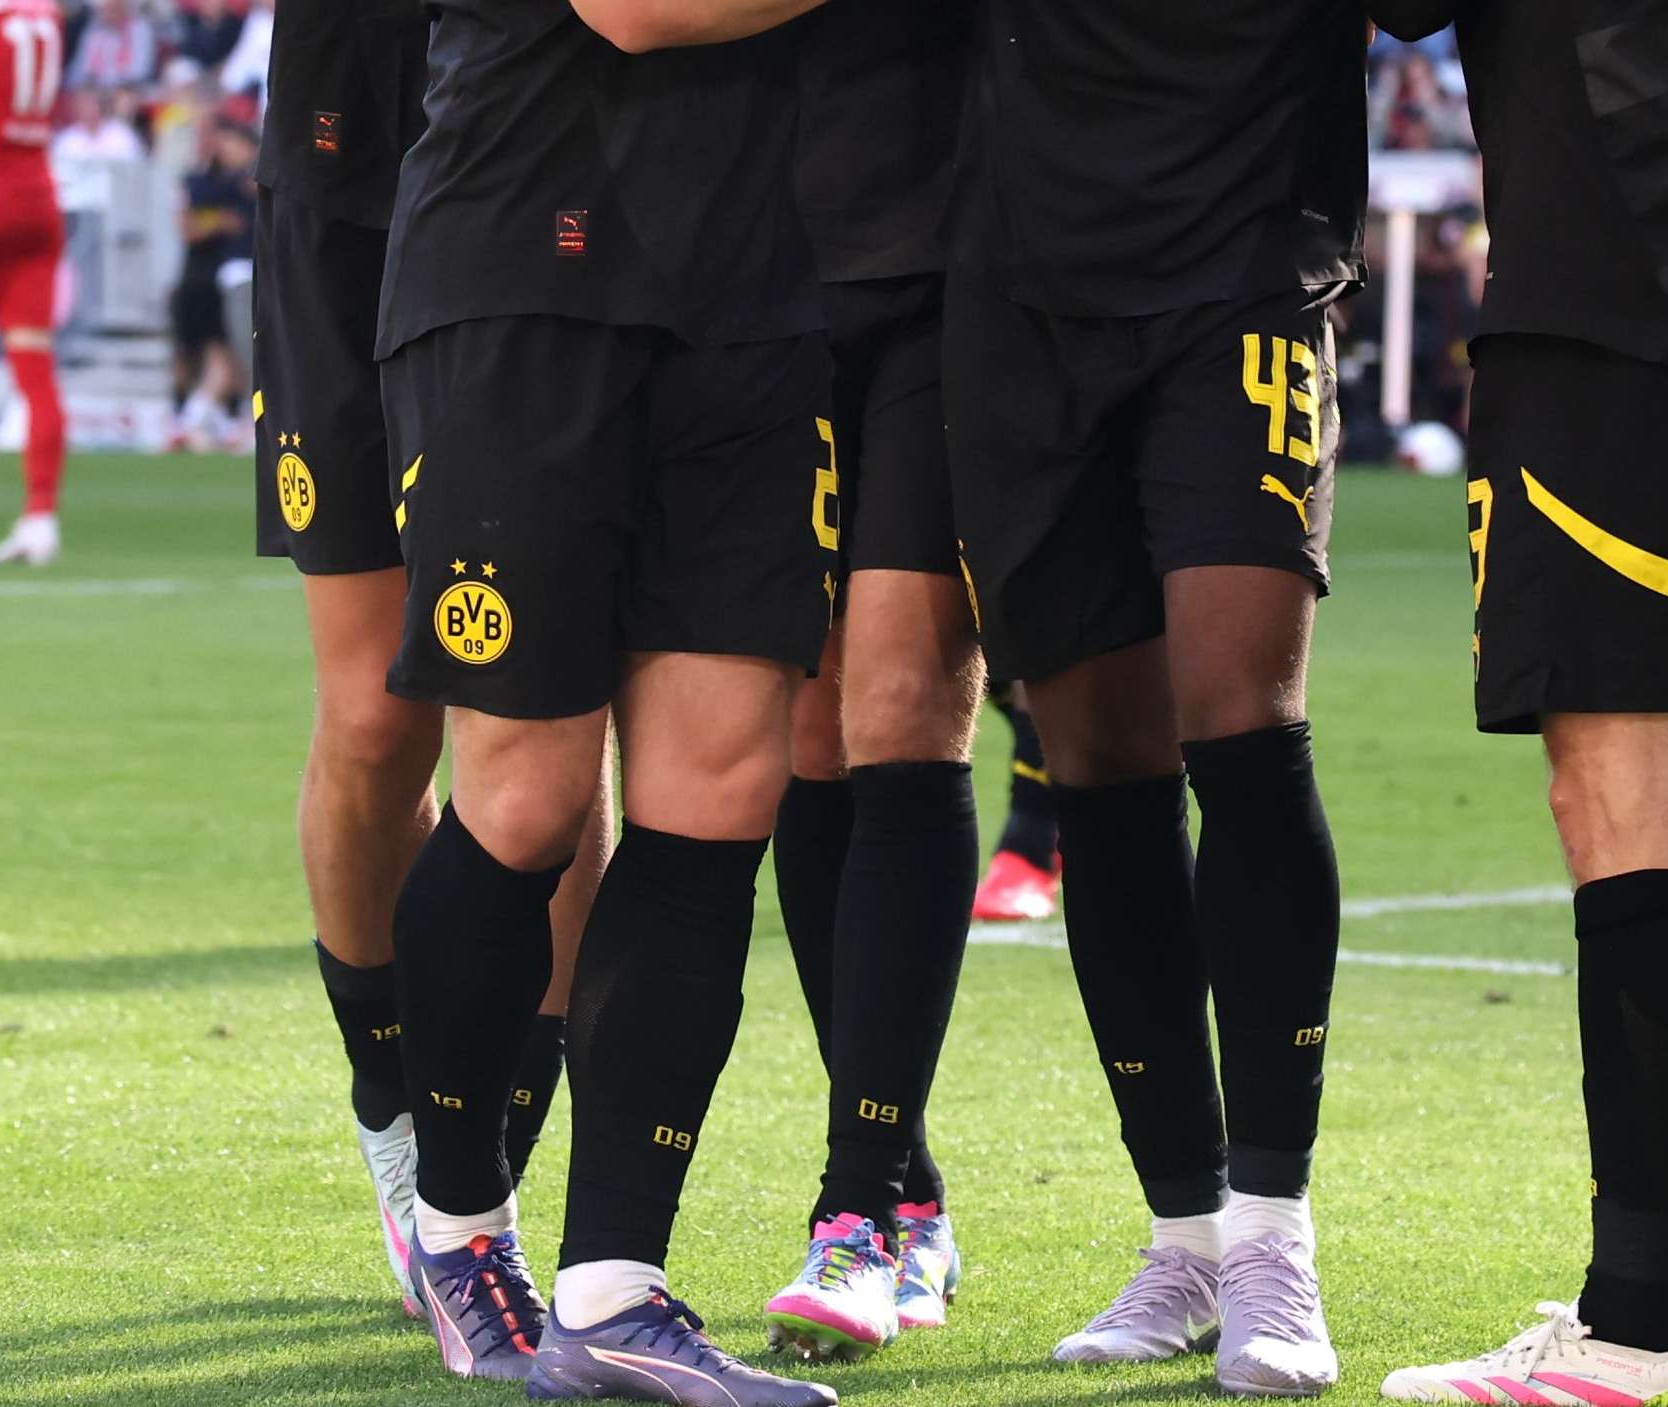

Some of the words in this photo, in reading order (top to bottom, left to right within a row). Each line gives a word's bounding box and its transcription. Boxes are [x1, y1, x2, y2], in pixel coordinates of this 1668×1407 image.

[1243, 334, 1320, 466] 43
[447, 591, 502, 640] BVB
[464, 638, 484, 655] 09
[858, 1098, 899, 1124] 09
[653, 1125, 692, 1152] 09
